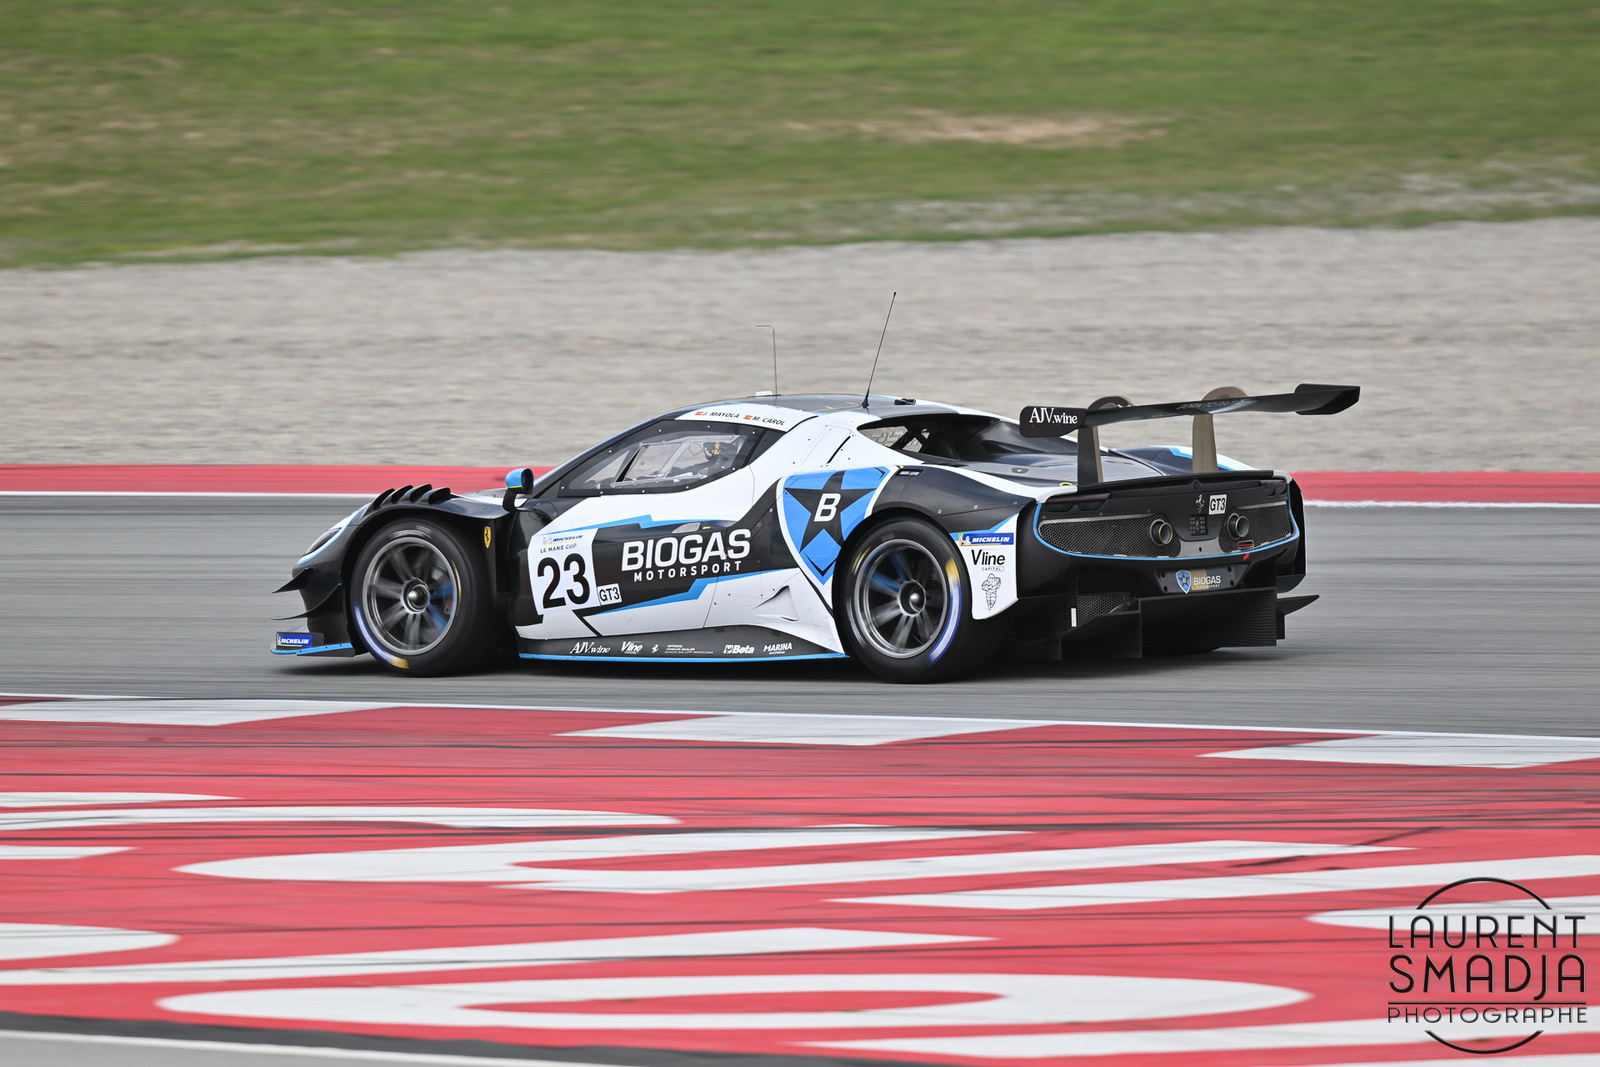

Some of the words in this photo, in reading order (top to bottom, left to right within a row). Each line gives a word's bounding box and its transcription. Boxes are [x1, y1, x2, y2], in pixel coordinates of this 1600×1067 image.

[709, 411, 740, 419] MAYOLA
[762, 417, 786, 426] CAROL
[1029, 407, 1078, 424] AJV.wine
[813, 493, 842, 522] B
[1210, 497, 1226, 512] GT3
[552, 534, 584, 543] MICHELIN
[565, 542, 577, 550] CUP
[620, 528, 752, 571] BIOGAS
[971, 549, 1006, 566] Vline
[633, 561, 742, 583] MOTORSPORT
[537, 552, 591, 609] 23
[1193, 575, 1222, 586] BIOGAS
[599, 586, 621, 602] GT3
[569, 641, 611, 654] AJV.wine
[731, 645, 755, 654] Beta
[763, 642, 793, 652] MARINA
